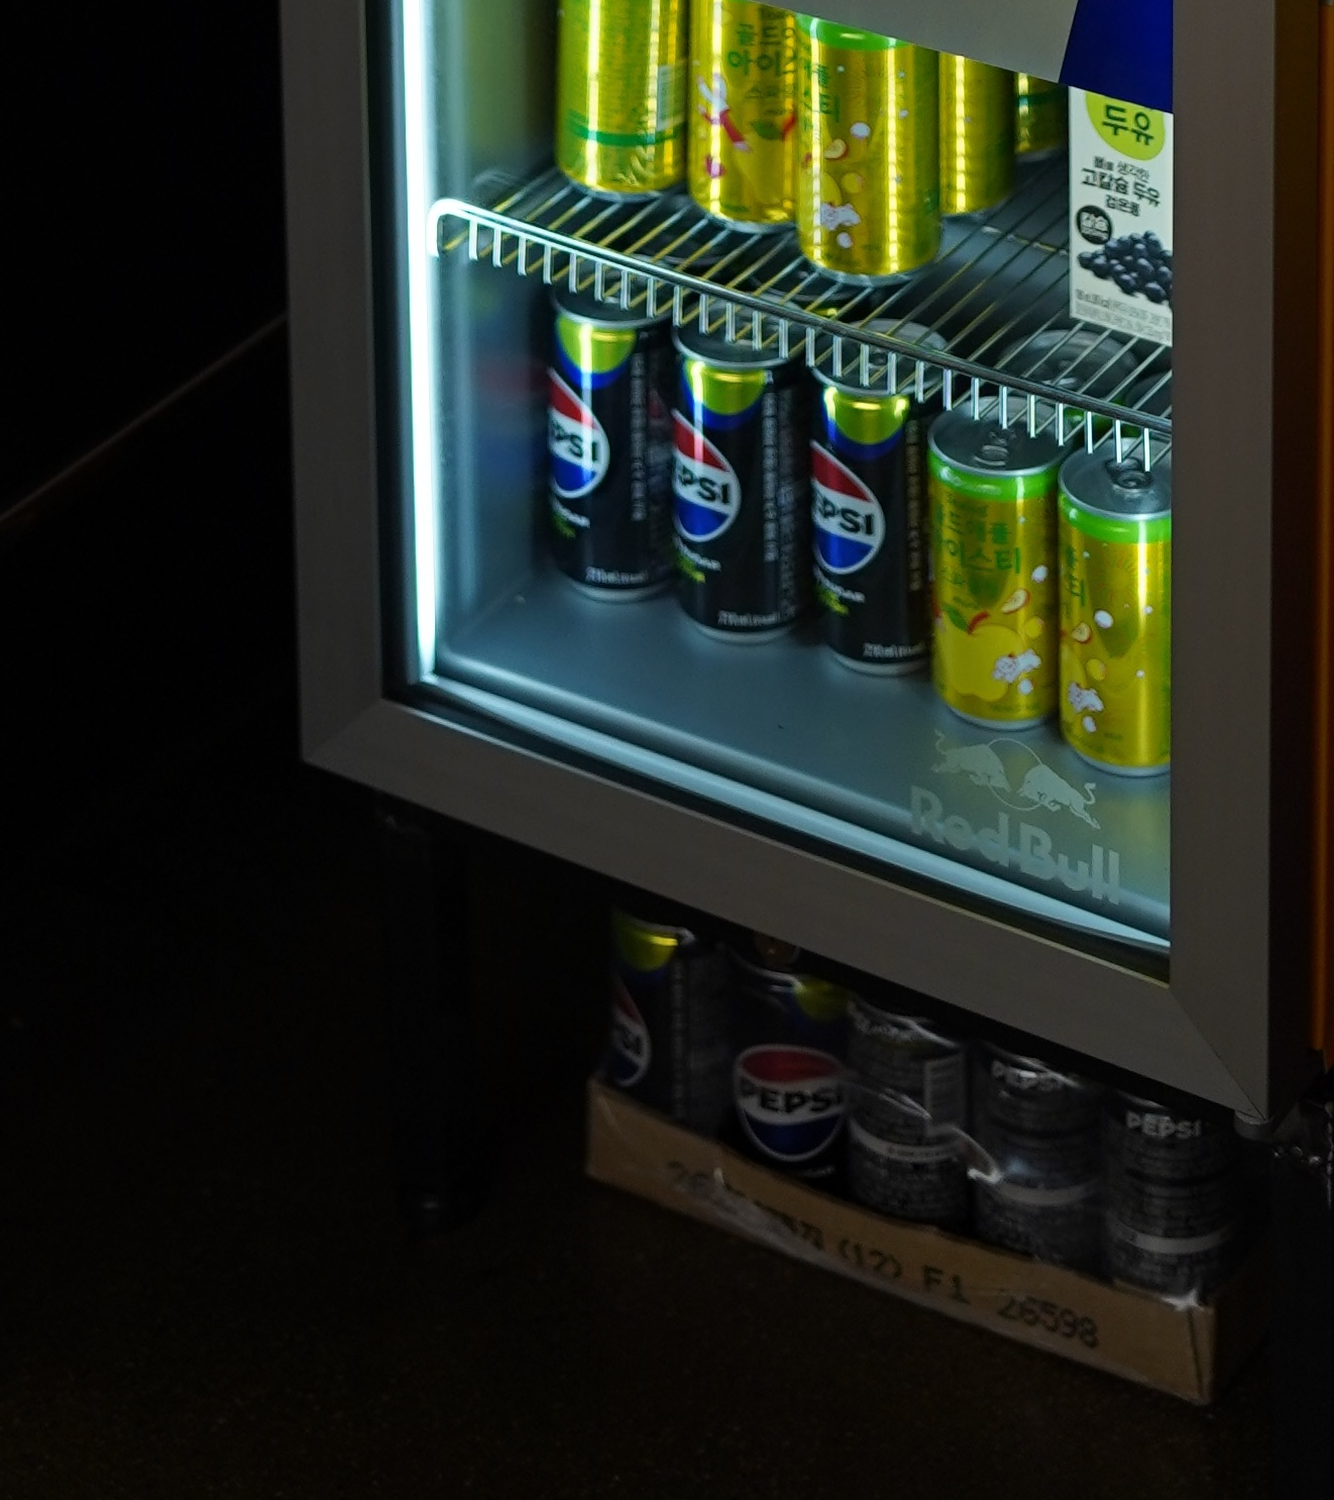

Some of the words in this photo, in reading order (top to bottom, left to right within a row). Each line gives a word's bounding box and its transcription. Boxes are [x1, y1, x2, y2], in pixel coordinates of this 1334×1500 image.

[1102, 104, 1154, 146] 두유
[1081, 167, 1128, 195] 고칼슘
[1133, 182, 1161, 207] 두유
[910, 785, 1010, 868] Red
[1019, 821, 1120, 906] Bull
[1124, 1107, 1203, 1140] PEPSI
